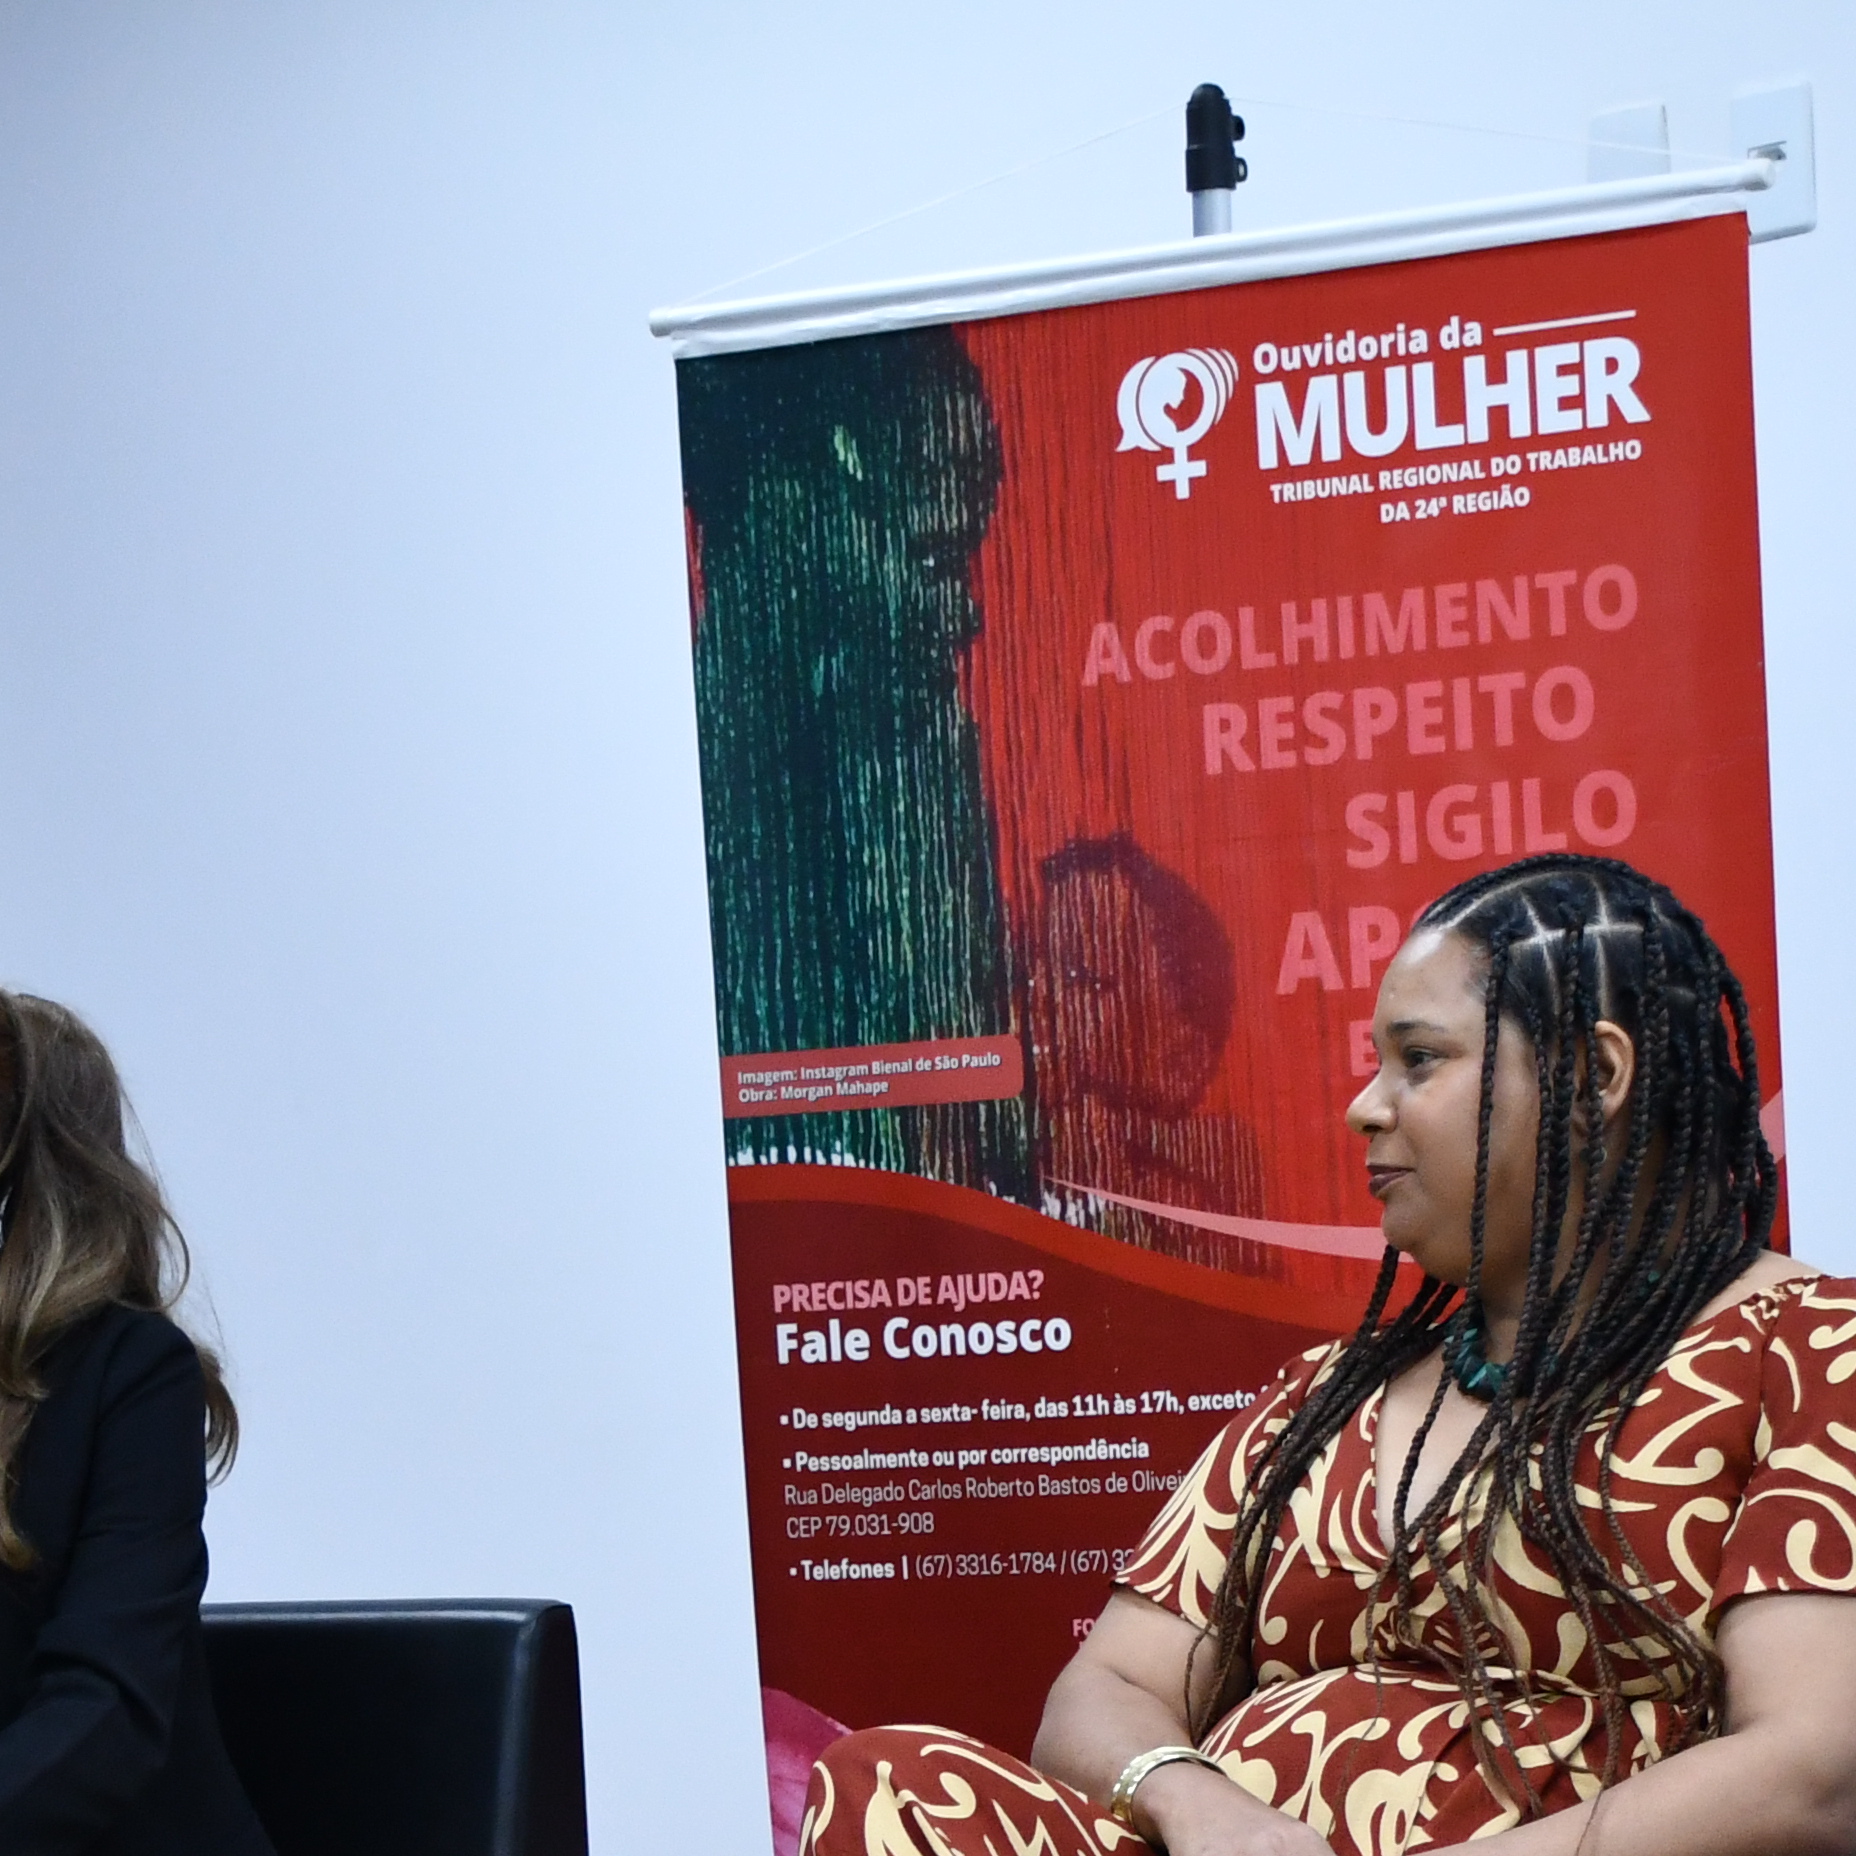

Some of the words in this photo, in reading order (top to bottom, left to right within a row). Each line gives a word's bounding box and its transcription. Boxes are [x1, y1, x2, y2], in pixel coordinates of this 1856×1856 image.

[1253, 324, 1428, 374] Ouvidoria
[1439, 316, 1482, 351] da
[1254, 336, 1651, 470] MULHER
[1270, 474, 1374, 503] TRIBUNAL
[1379, 459, 1485, 491] REGIONAL
[1491, 455, 1521, 477] DO
[1527, 439, 1642, 473] TRABALHO
[1380, 501, 1410, 524] DA
[1453, 484, 1530, 515] REGIÃO
[1081, 564, 1638, 688] ACOLHIMENTO
[1201, 665, 1595, 775] RESPEITO
[1345, 770, 1637, 869] SIGILO
[737, 1069, 798, 1086] Imagem:
[800, 1064, 870, 1083] Instagram
[872, 1059, 913, 1075] Bienal
[915, 1057, 932, 1072] de
[934, 1054, 959, 1071] São
[962, 1052, 1001, 1068] Paulo
[738, 1086, 777, 1103] Obra:
[780, 1084, 833, 1102] Morgan
[837, 1078, 889, 1096] Mahape
[773, 1279, 892, 1313] PRECISA
[896, 1276, 933, 1308] DE
[936, 1269, 1044, 1312] AJUDA?
[775, 1318, 870, 1365] Fale
[883, 1316, 1073, 1360] Conosco
[793, 1407, 818, 1429] De
[822, 1403, 902, 1431] segunda
[906, 1408, 917, 1423] a
[981, 1398, 1031, 1422] feira,
[1034, 1396, 1069, 1418] das
[1072, 1393, 1109, 1416] 11h
[1113, 1393, 1136, 1414] às
[1140, 1390, 1184, 1415] 17h,
[796, 1448, 929, 1472] Pessoalmente
[932, 1451, 954, 1467] ou
[958, 1449, 987, 1470] por
[991, 1437, 1149, 1466] correspondência
[784, 1484, 817, 1505] Rua
[821, 1480, 904, 1507] Delegado
[908, 1478, 962, 1501] Carlos
[965, 1476, 1034, 1499] Roberto
[1038, 1474, 1101, 1496] Bastos
[1105, 1471, 1128, 1493] de
[786, 1515, 822, 1538] CEP
[825, 1512, 934, 1537] 79.031-908
[800, 1557, 895, 1581] Telefones
[915, 1554, 953, 1579] (67)
[956, 1550, 1056, 1576] 3316-1784
[1070, 1549, 1108, 1575] (67)
